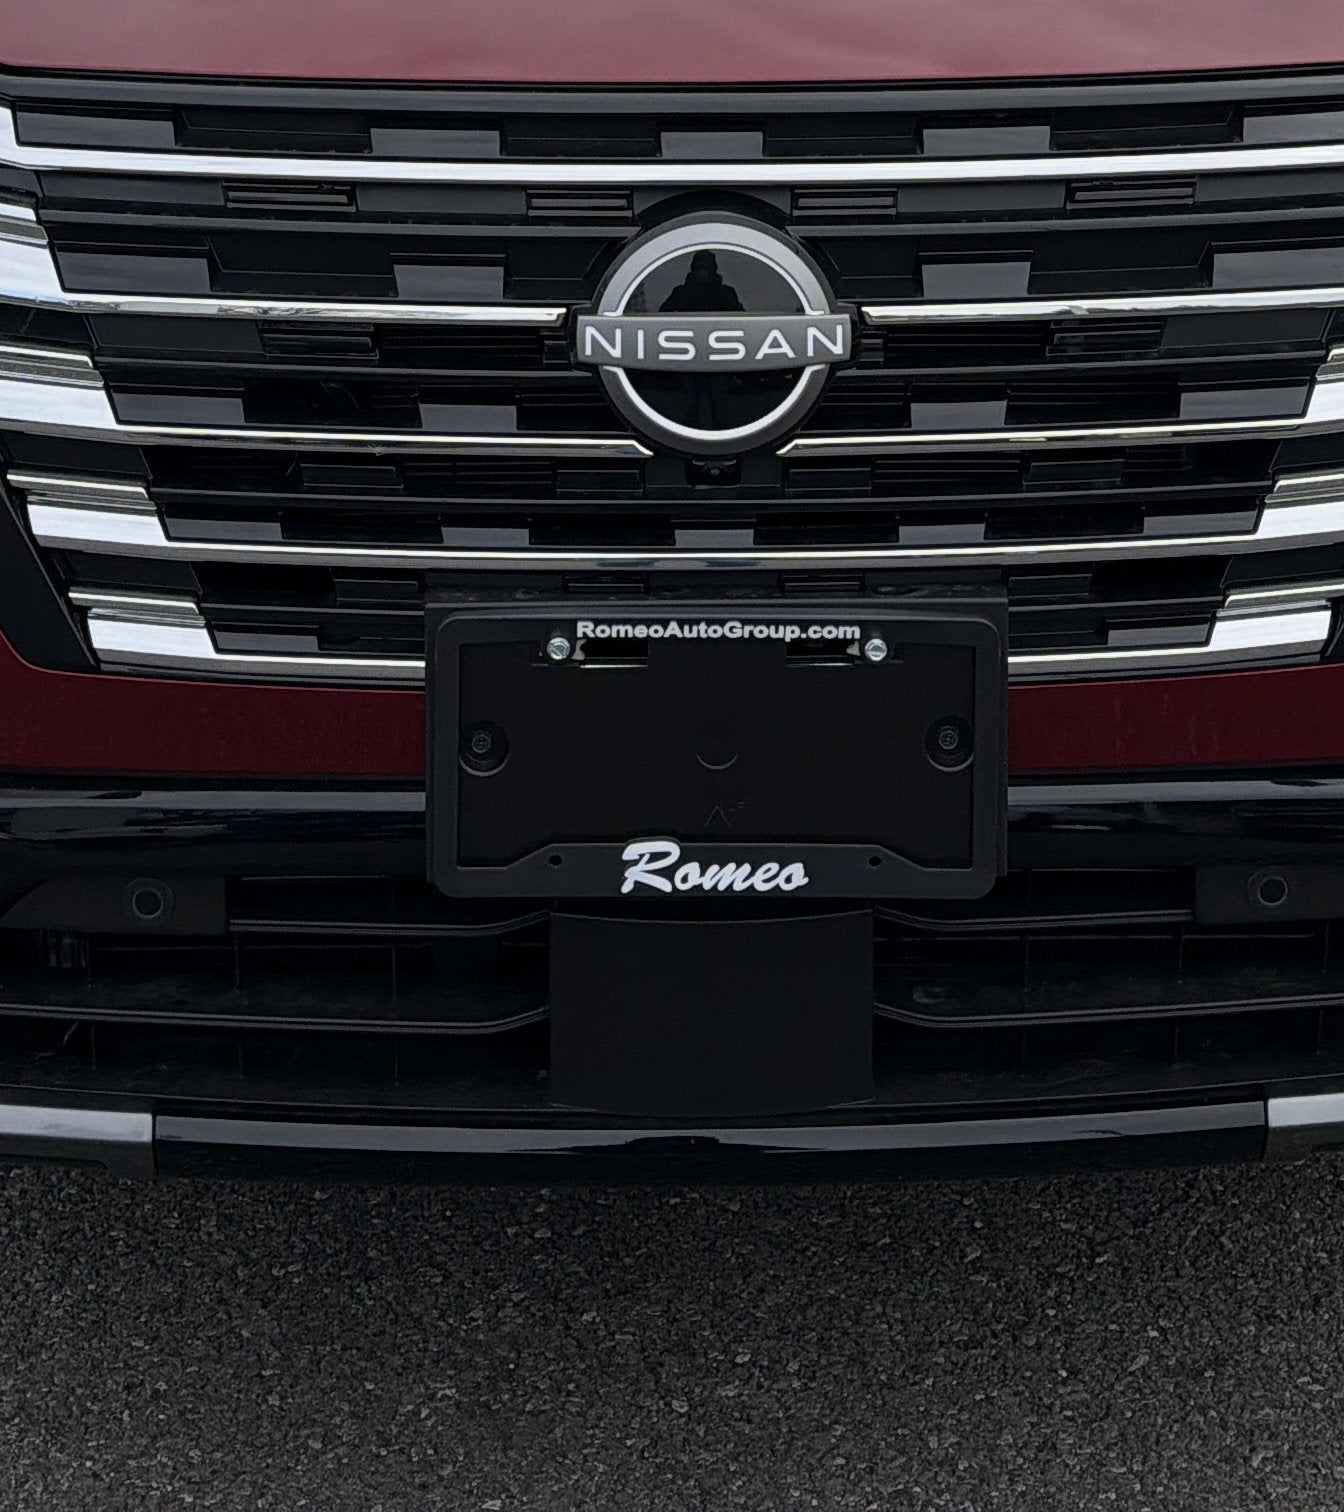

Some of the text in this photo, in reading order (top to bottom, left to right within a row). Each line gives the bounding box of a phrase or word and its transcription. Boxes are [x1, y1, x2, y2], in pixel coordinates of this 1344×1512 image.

[584, 324, 844, 361] NISSAN
[576, 621, 861, 642] RomeoAutoGroup.com
[620, 840, 809, 894] Romeo
